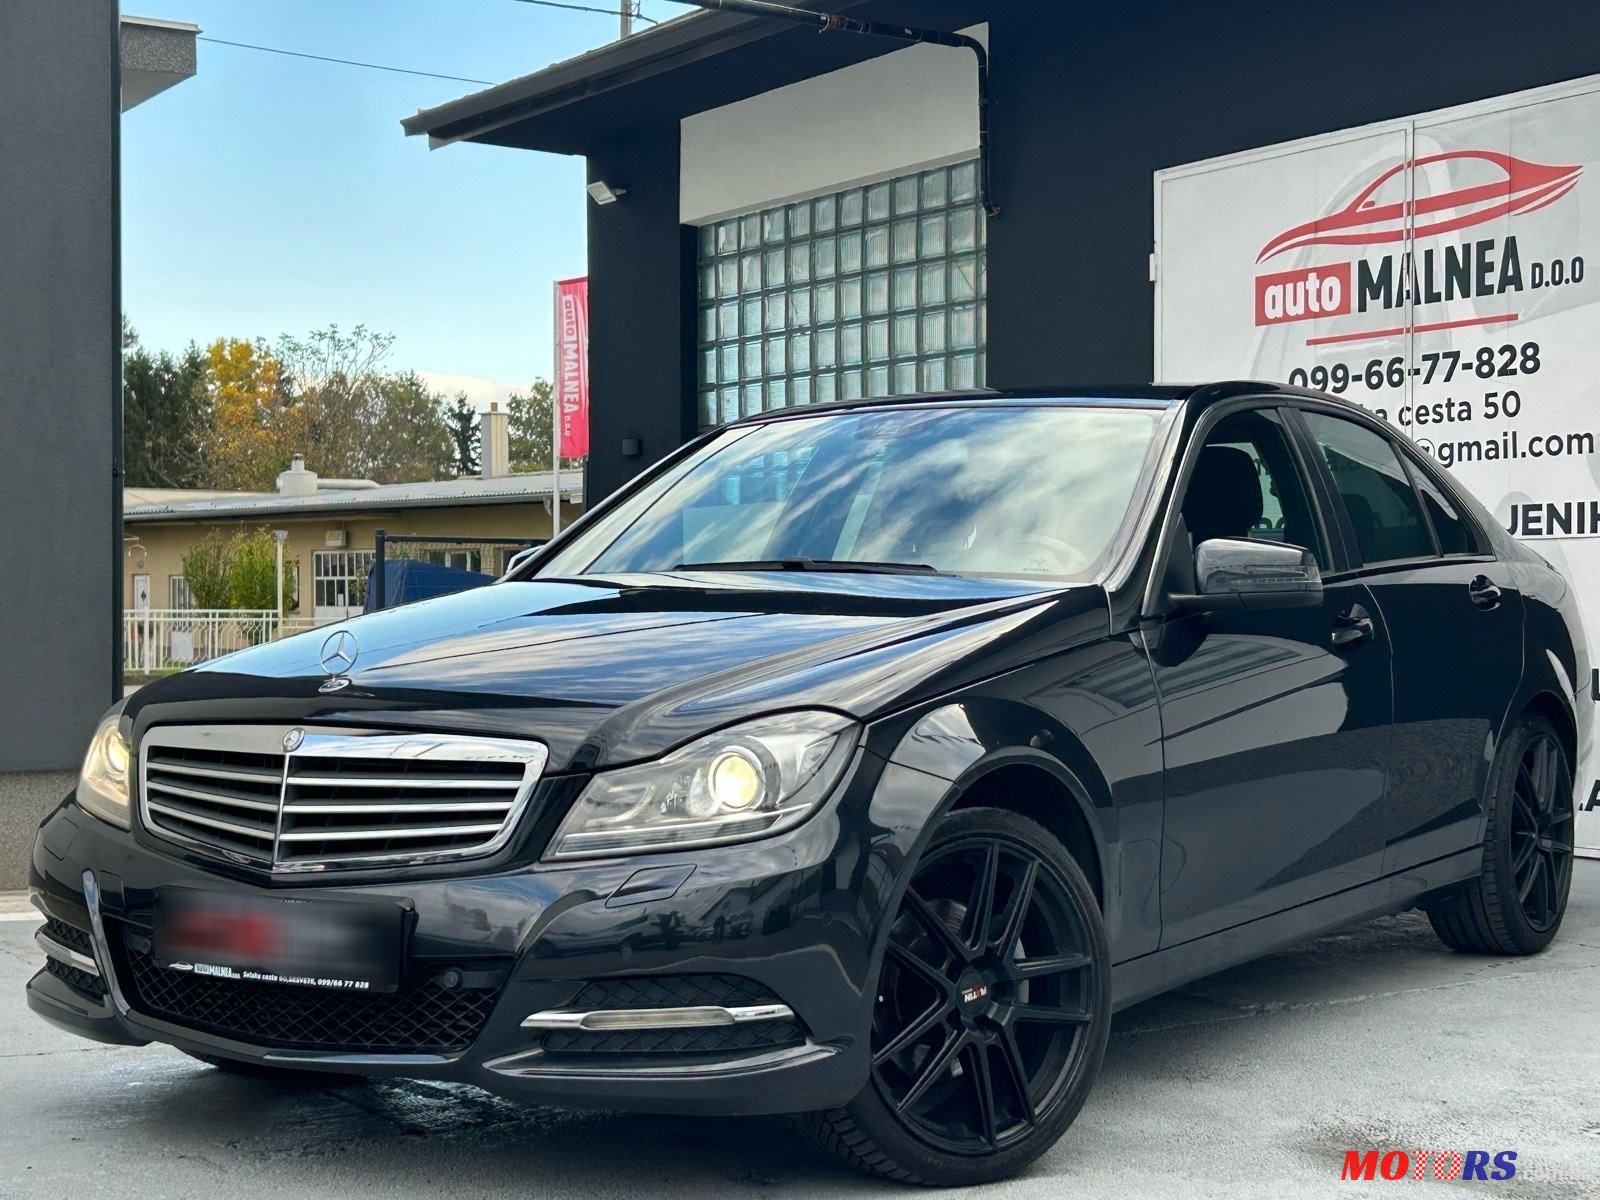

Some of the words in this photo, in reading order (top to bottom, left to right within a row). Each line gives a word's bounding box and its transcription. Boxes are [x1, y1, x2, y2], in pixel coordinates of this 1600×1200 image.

[1263, 272, 1342, 320] auto
[1357, 235, 1524, 313] MALNEA
[1530, 256, 1585, 290] D.O.O
[563, 343, 580, 413] MALNEA
[1288, 342, 1541, 394] 099-66-77-828
[1398, 398, 1472, 427] cesta
[1483, 390, 1521, 419] 50
[344, 980, 354, 988] 77
